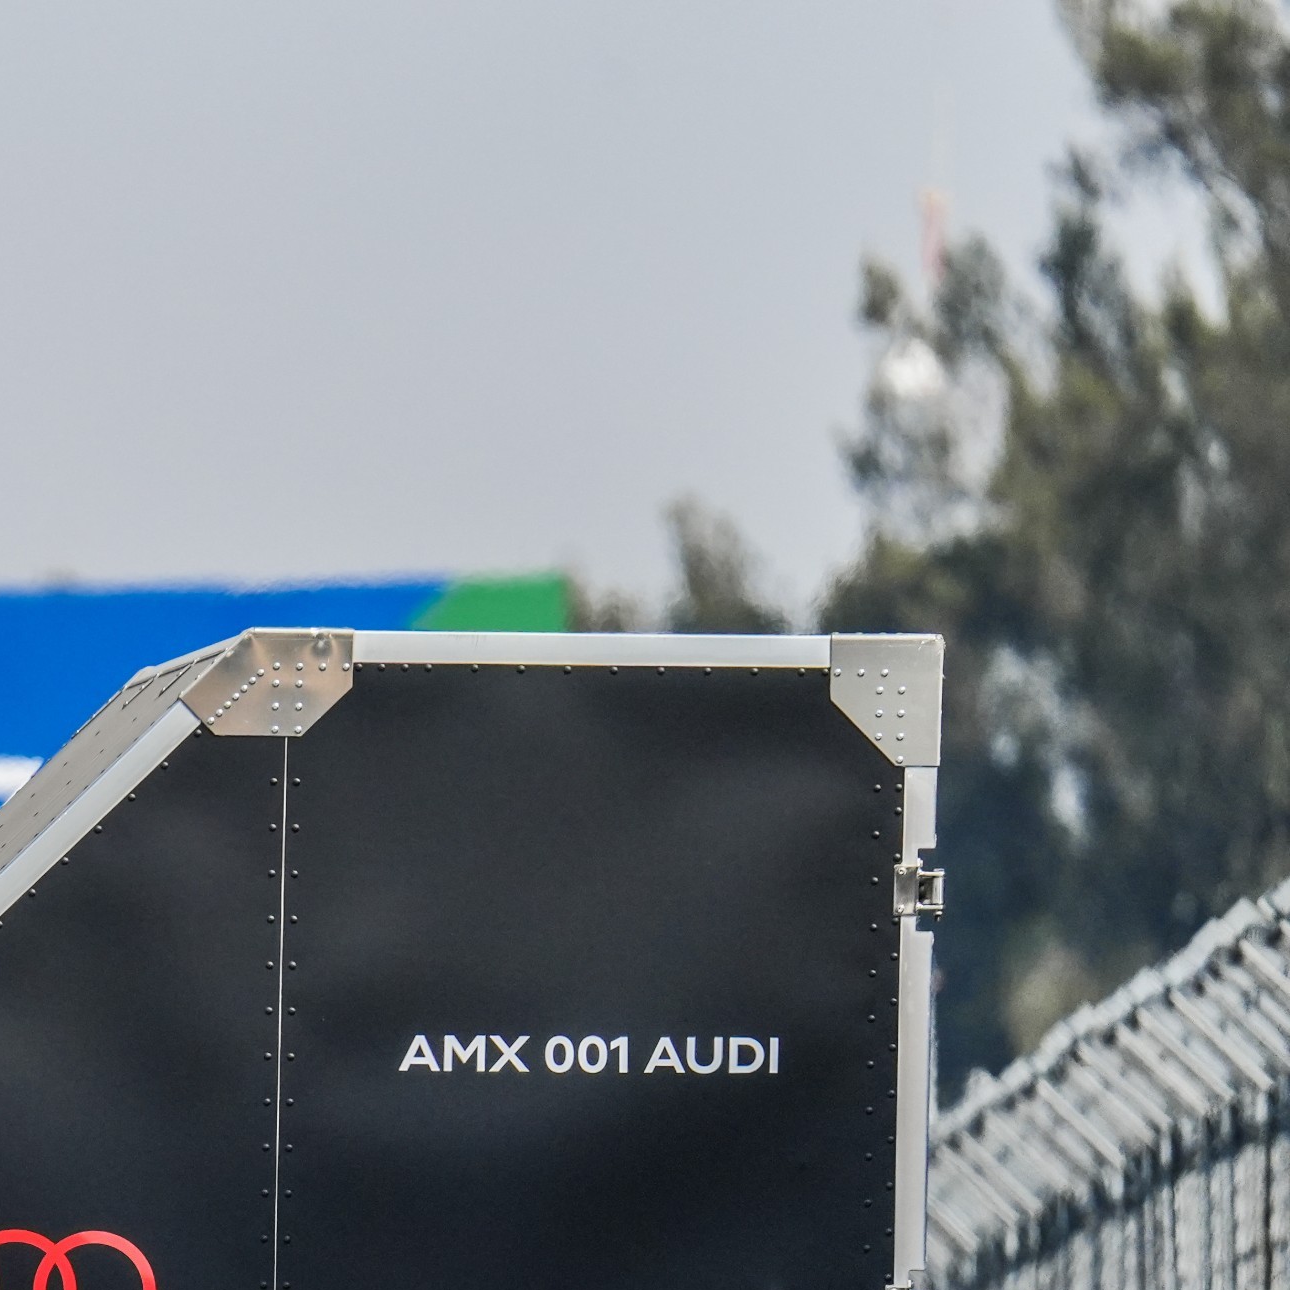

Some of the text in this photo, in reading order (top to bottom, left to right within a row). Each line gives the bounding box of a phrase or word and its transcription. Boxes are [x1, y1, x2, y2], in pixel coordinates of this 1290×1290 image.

[399, 1034, 780, 1074] AMX 001 AUDI
